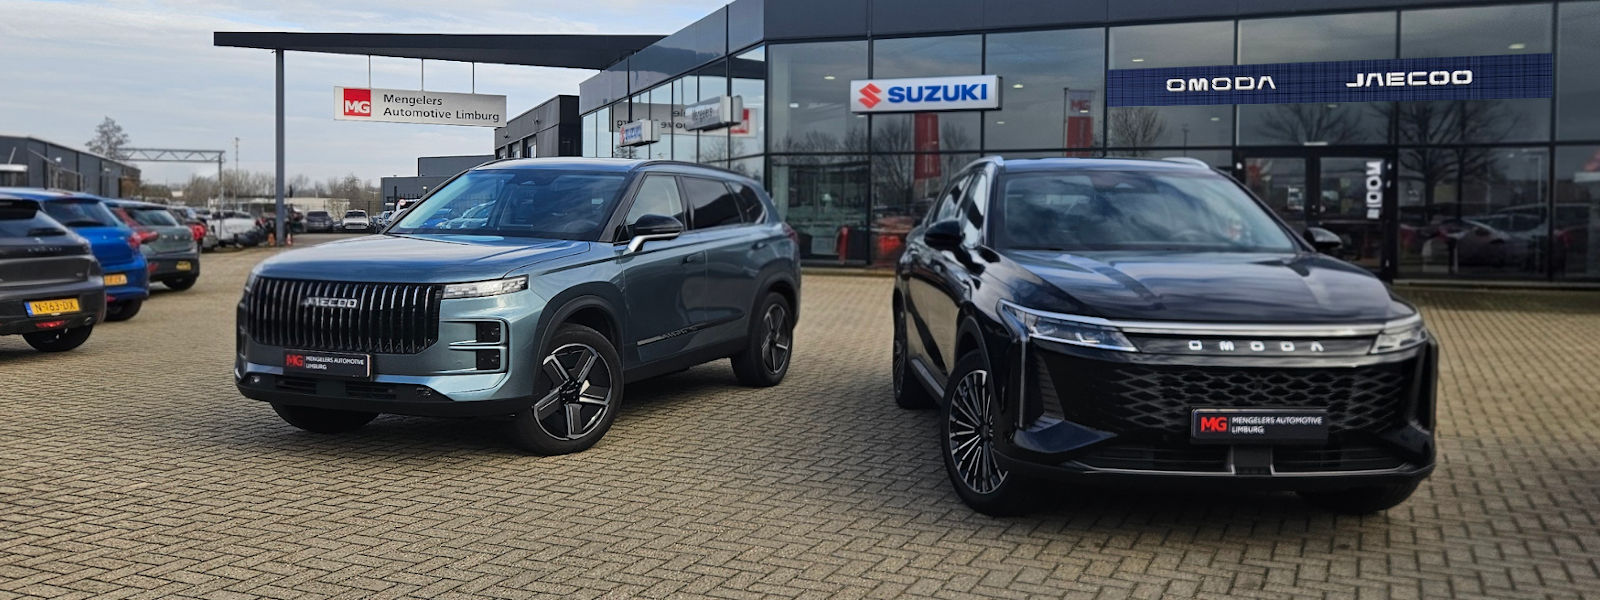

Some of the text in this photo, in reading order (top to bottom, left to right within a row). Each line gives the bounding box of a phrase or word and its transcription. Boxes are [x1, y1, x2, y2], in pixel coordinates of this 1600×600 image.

[1166, 69, 1474, 92] OMODA JAECOO
[887, 83, 987, 103] SUZUKI
[383, 94, 443, 107] Mengelers
[344, 100, 371, 115] MG
[383, 107, 500, 123] Automotive Limburg
[34, 301, 75, 313] N-163-DX
[1188, 339, 1325, 352] OMODA
[286, 354, 304, 367] MG
[1200, 416, 1228, 433] MG
[1231, 416, 1323, 426] MENGELERS AUTOMOTIVE
[1231, 425, 1265, 434] LIMBURG
